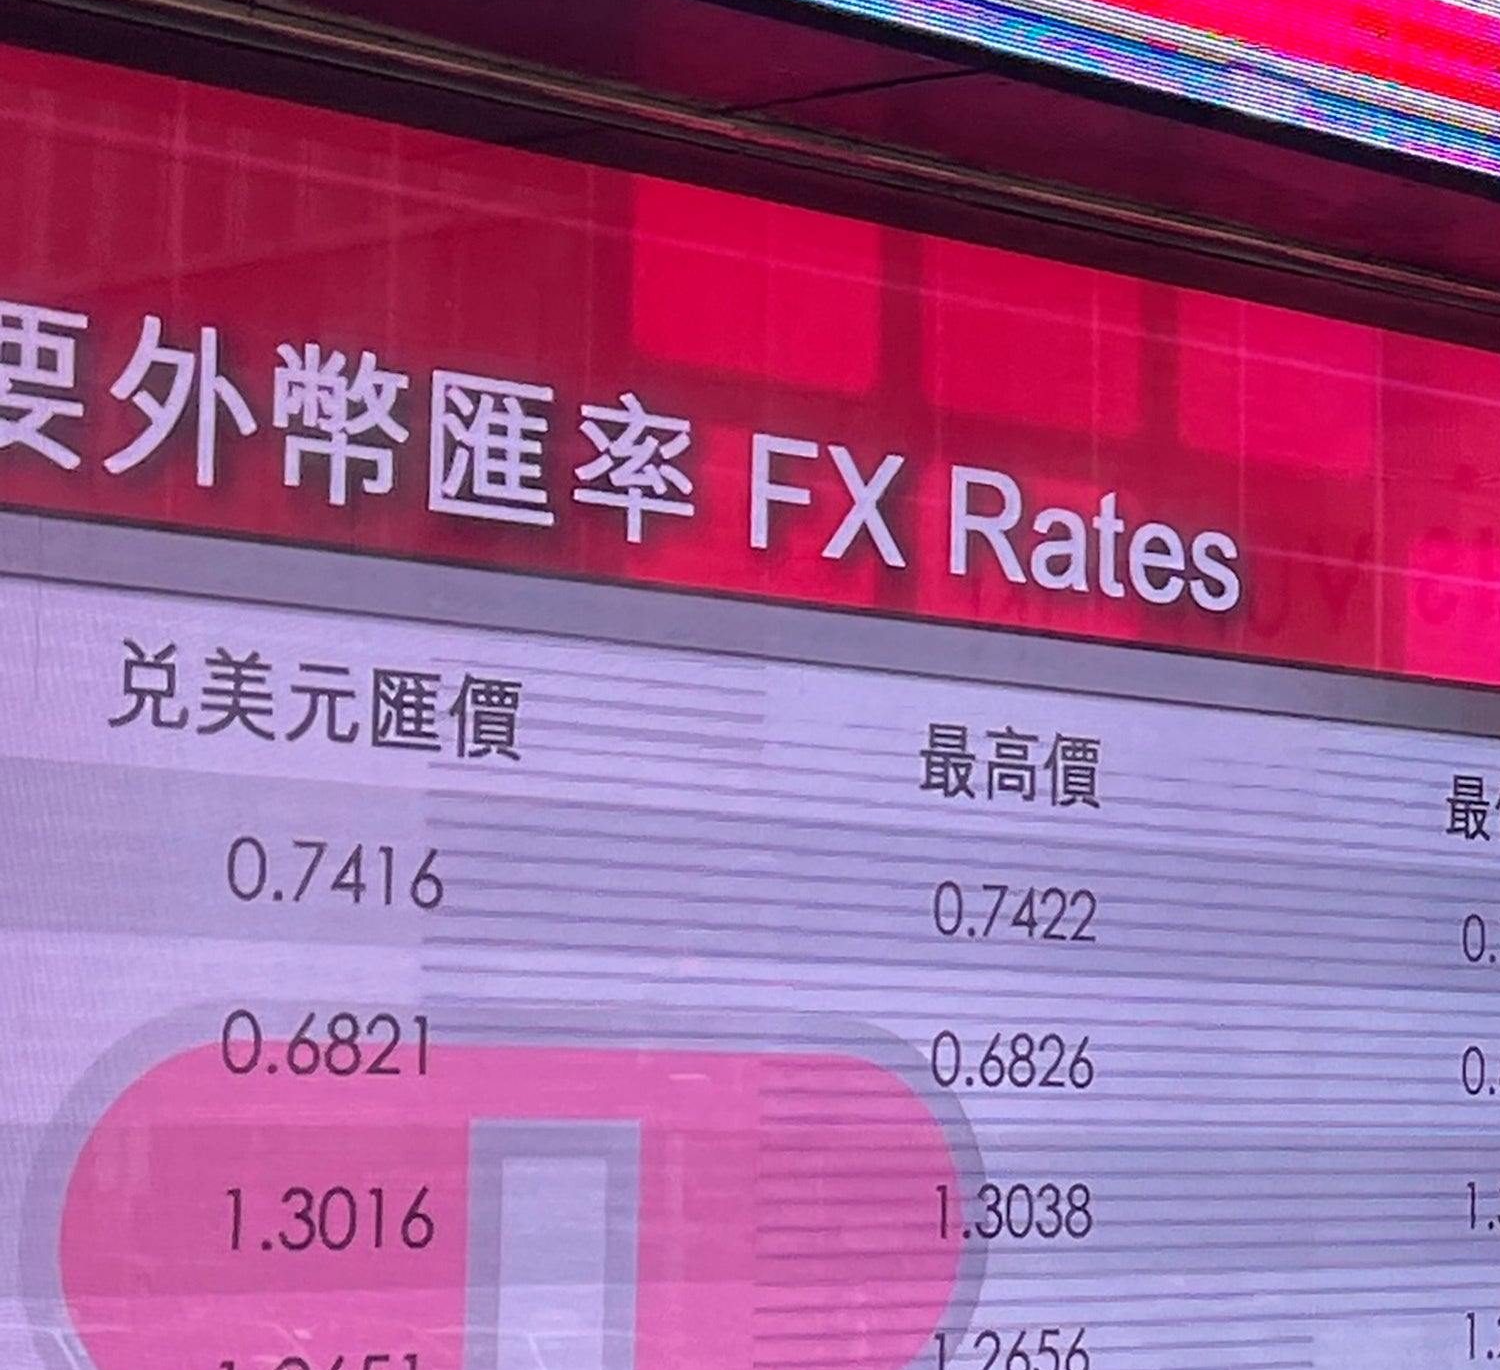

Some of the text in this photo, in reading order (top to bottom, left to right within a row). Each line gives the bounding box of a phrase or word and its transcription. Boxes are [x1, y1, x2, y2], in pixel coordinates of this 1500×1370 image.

[0, 296, 696, 543] 要外幣匯率
[749, 430, 906, 569] FX
[947, 463, 1242, 615] Rates
[920, 722, 1102, 810] 最高價
[225, 836, 445, 911] 0.7416
[933, 880, 1098, 945] 0.7422
[221, 1009, 431, 1077] 0.6821
[930, 1030, 1095, 1090] 0.6826
[225, 1187, 435, 1252] 1.3016
[934, 1182, 1094, 1240] 1.3038
